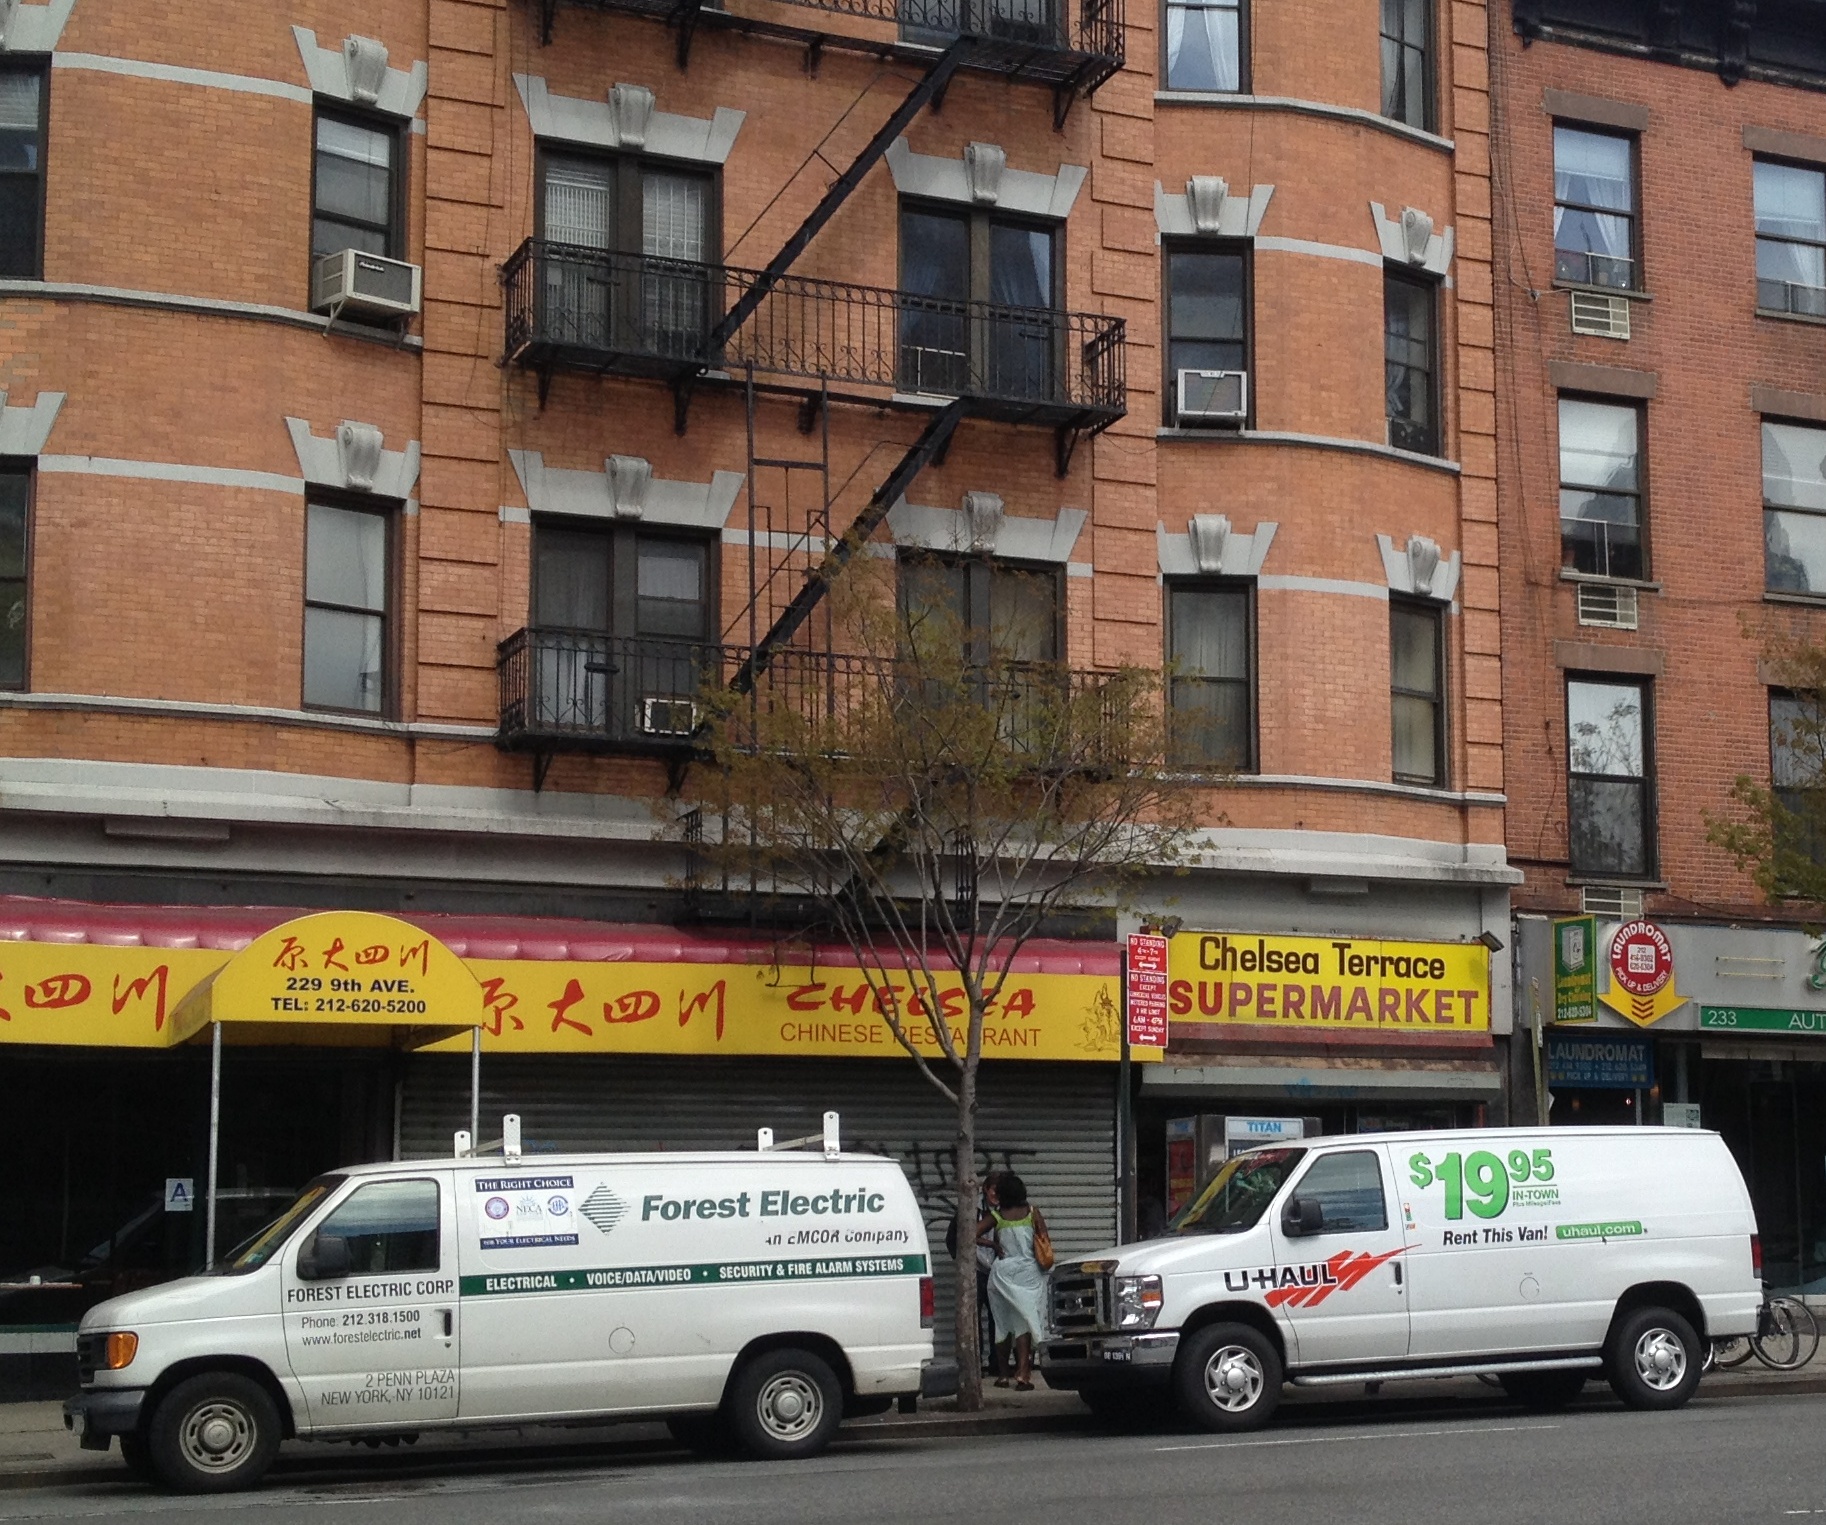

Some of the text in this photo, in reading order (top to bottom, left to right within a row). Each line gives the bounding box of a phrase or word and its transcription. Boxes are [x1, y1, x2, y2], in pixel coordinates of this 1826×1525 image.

[1130, 937, 1165, 949] NO STANDING
[1612, 921, 1671, 962] LAUNDROMAT
[1199, 935, 1446, 980] Chelsea Terrace
[286, 977, 415, 994] 229 9th AVE.
[1131, 973, 1165, 985] NO STANDING
[1139, 983, 1157, 991] EXCEPT
[1616, 967, 1629, 984] PICK
[1627, 979, 1637, 989] UP
[1643, 970, 1669, 991] DELIVERY
[0, 964, 168, 1032] 四川
[271, 997, 426, 1013] TEL: 212-620-5200
[1169, 979, 1479, 1024] SUPERMARKET
[1708, 1010, 1737, 1025] 233
[780, 1022, 1042, 1047] CHINESE RESARANT
[1130, 1024, 1165, 1034] EXCEPT SUNDAY
[1547, 1042, 1645, 1061] LAUNDROMAT
[1566, 1071, 1581, 1081] PICK
[1583, 1071, 1592, 1081] UP
[1601, 1071, 1629, 1082] DELIVERY
[1246, 1121, 1282, 1133] TITAN
[170, 1182, 189, 1203] A
[477, 1178, 572, 1190] THE RIGHT CHOICE
[641, 1187, 885, 1221] Forest Electric
[1512, 1188, 1559, 1202] IN-TOWN
[515, 1236, 553, 1244] ELECTRICAL
[554, 1234, 576, 1242] NEEDS
[1443, 1223, 1637, 1246] Rent This Van! uhaul.com
[486, 1258, 904, 1291] ELECTRICAL VOICE/DATA/VIDEO SECURITY & FIRE ALARM SYSTEMS
[1224, 1263, 1338, 1292] U-HAUL
[287, 1286, 342, 1303] FOREST
[346, 1281, 412, 1299] ELECTRIC
[301, 1310, 420, 1329] Phone: 212.318.1500
[302, 1327, 421, 1346] www.forestelectric.net
[366, 1369, 455, 1388] 2 PENN PLAZA
[321, 1385, 454, 1406] NEW YORK, NY 10121
